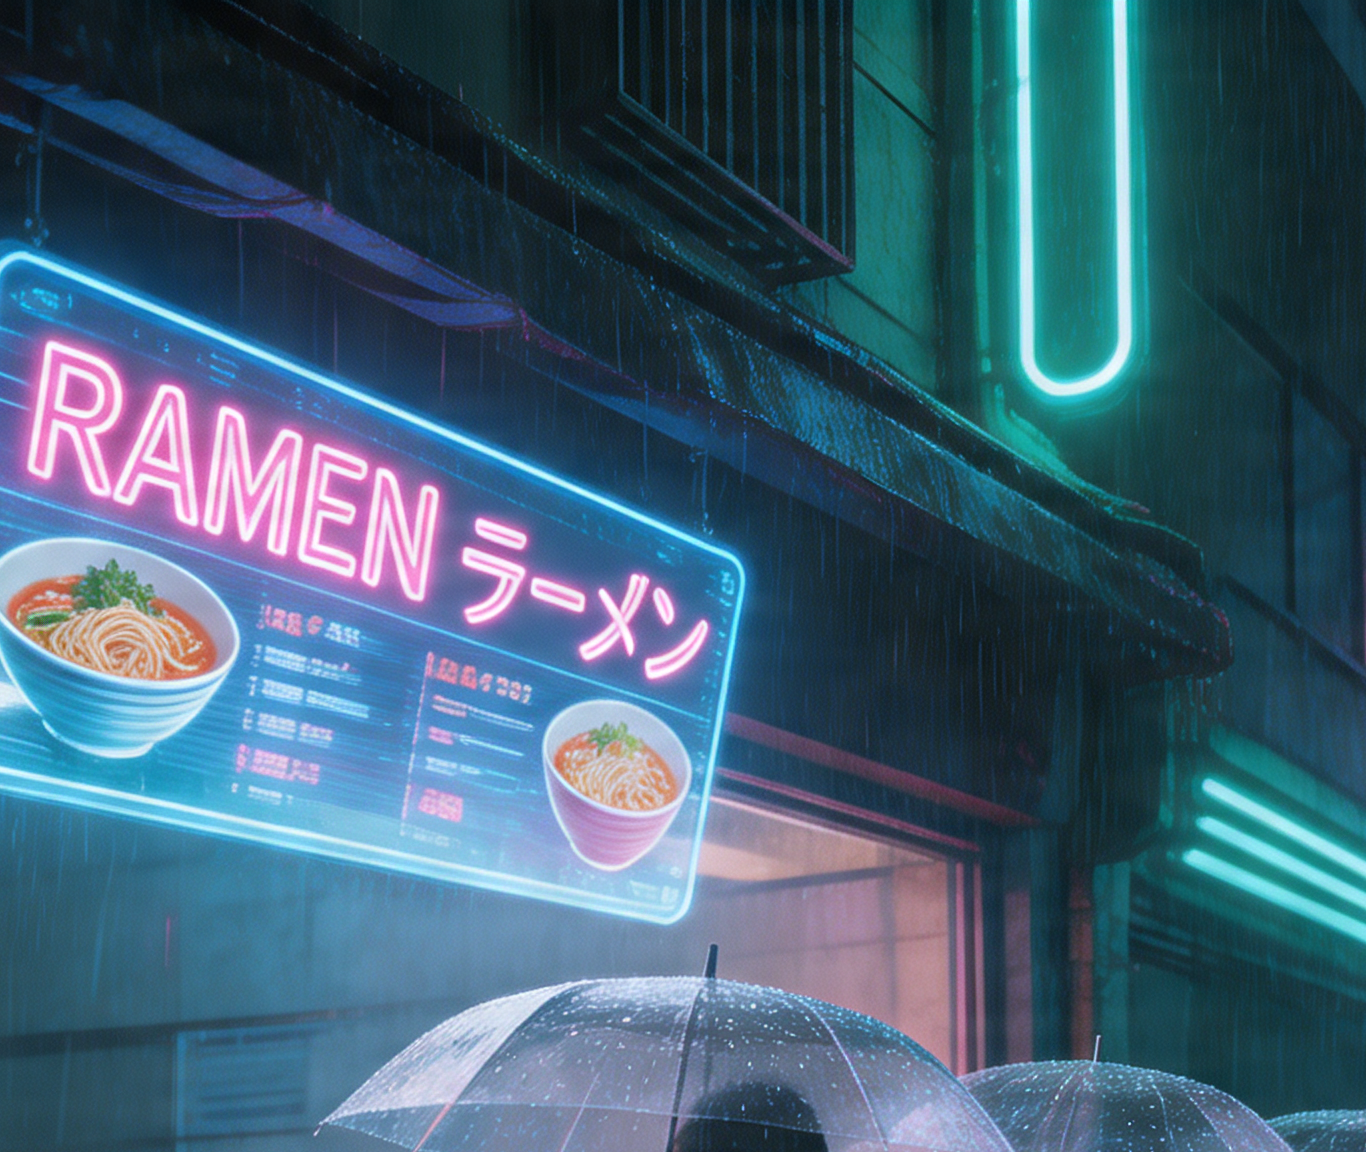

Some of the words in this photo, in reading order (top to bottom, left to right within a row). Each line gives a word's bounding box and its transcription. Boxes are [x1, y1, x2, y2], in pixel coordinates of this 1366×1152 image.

[26, 340, 440, 603] RAMEN
[461, 516, 710, 680] ラーメン
